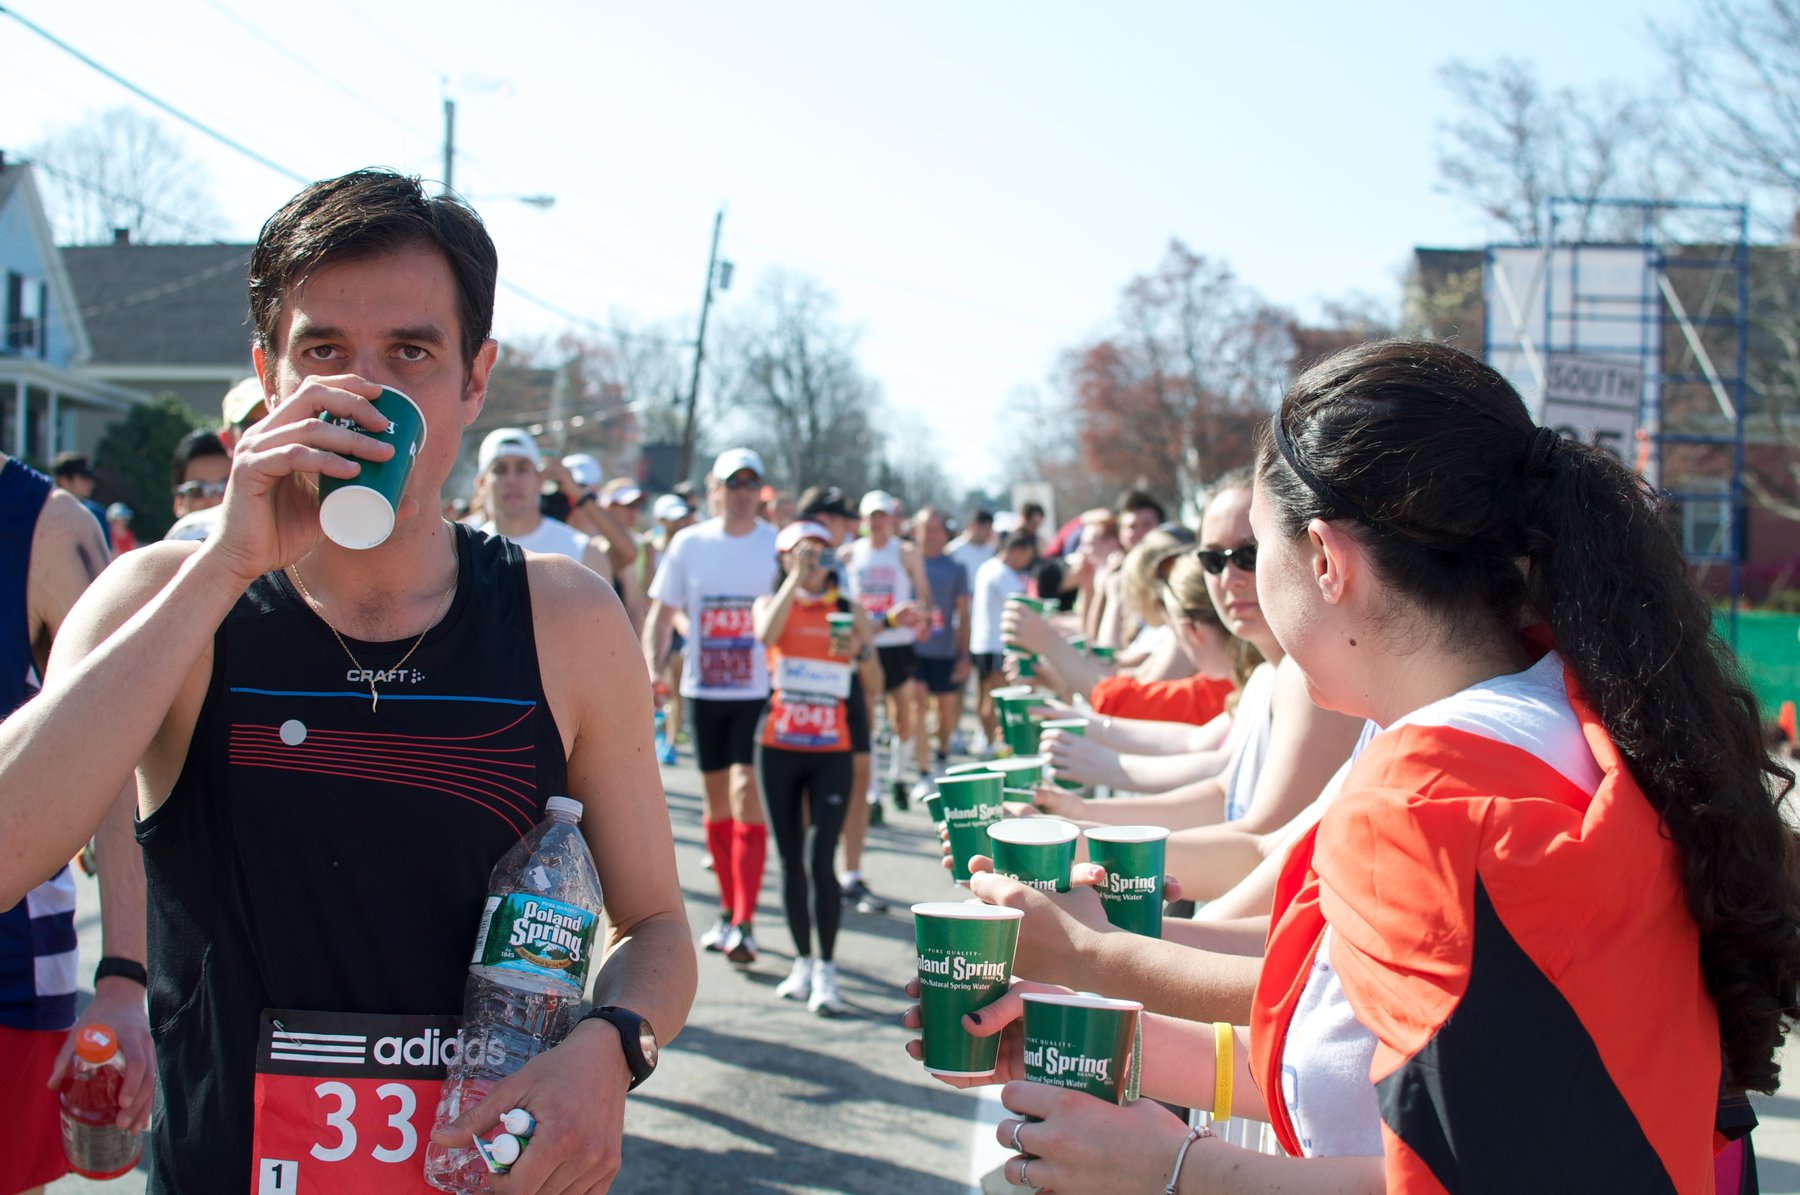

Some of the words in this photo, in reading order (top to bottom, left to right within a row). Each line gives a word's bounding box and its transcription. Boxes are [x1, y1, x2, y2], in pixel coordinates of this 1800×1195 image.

[1548, 363, 1636, 400] SOUTH
[346, 669, 409, 682] CRAFT
[1110, 872, 1157, 893] Spring
[1102, 894, 1121, 902] Spring
[523, 901, 582, 932] Poland
[509, 918, 582, 962] Spring
[952, 956, 1005, 982] Spring
[928, 979, 949, 988] Natural
[949, 982, 971, 991] Spring
[373, 1028, 506, 1066] adidas
[1024, 1046, 1043, 1068] and
[1045, 1046, 1108, 1081] Spring
[1042, 1076, 1065, 1087] Spring
[1066, 1079, 1088, 1089] Water
[271, 1163, 283, 1189] 1
